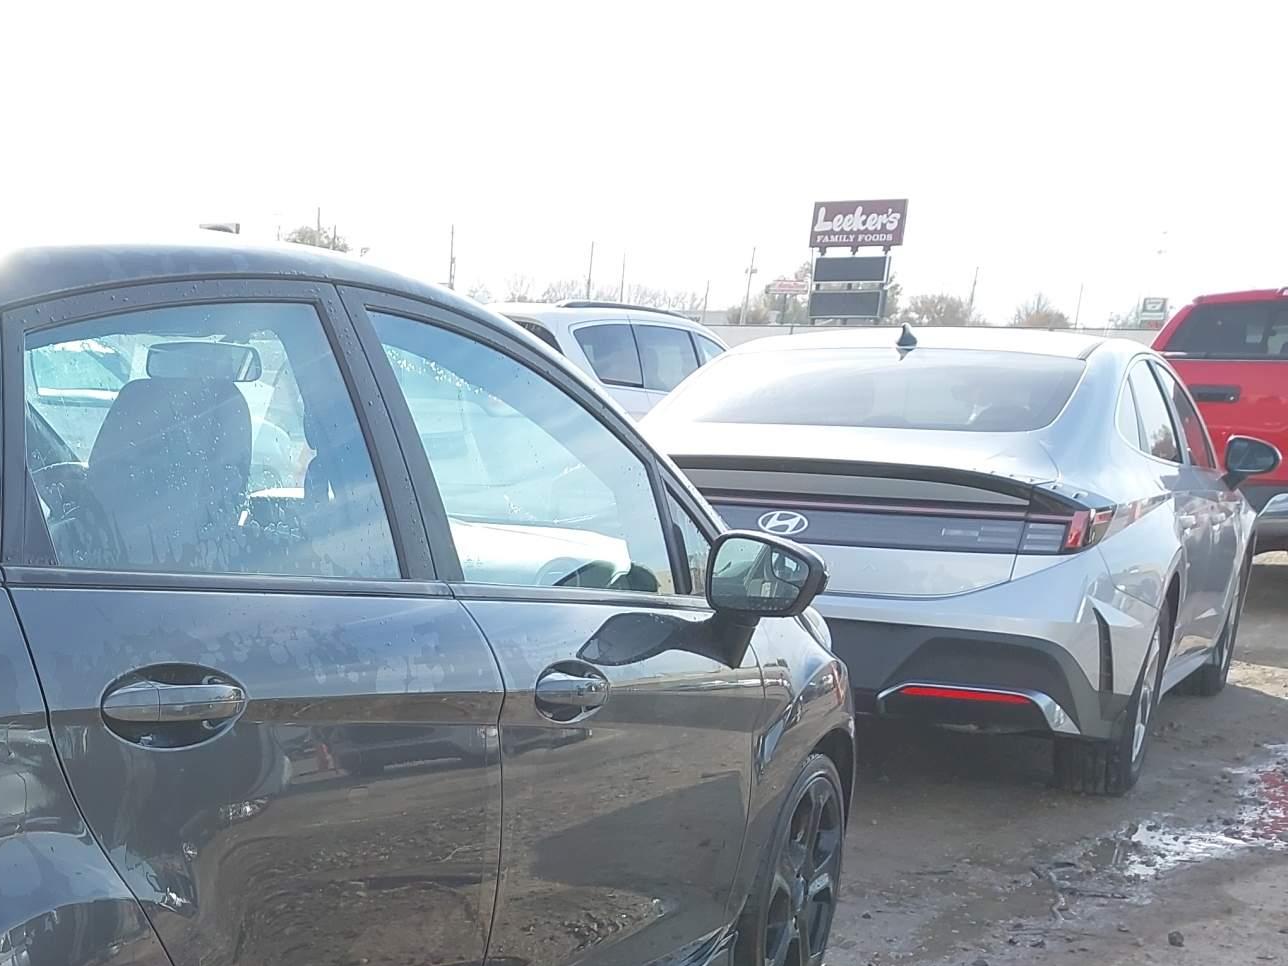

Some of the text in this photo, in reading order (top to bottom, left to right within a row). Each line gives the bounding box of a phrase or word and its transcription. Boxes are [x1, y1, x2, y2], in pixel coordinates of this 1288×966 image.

[814, 206, 901, 232] Leeker's
[816, 234, 893, 243] FAMILY FOODS
